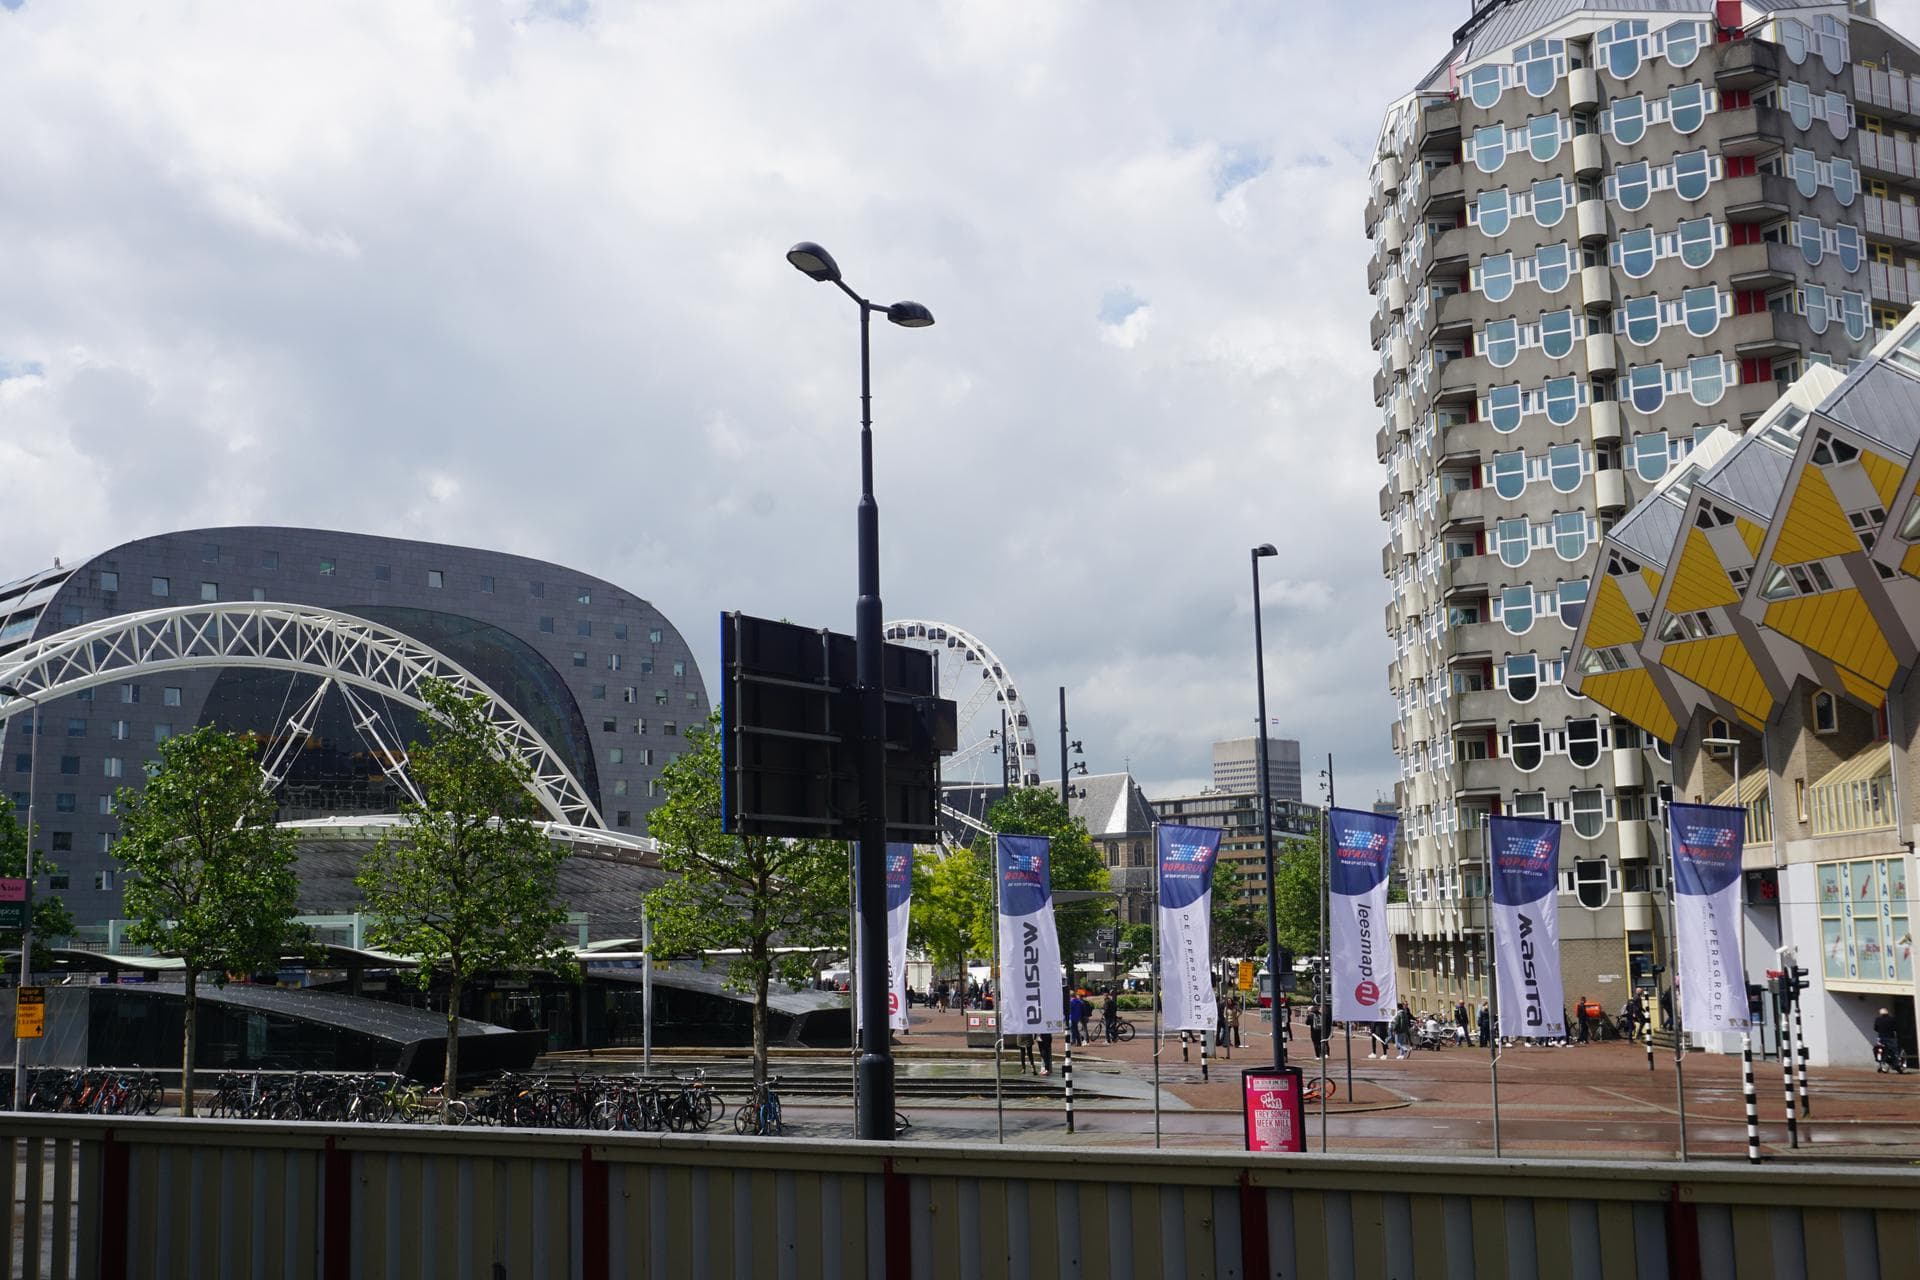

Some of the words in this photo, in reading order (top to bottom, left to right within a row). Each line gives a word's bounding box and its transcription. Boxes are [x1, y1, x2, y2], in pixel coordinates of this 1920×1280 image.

[1357, 903, 1378, 1003] leesmap.nl
[1843, 864, 1857, 977] CASINO
[1880, 862, 1895, 978] CASINO
[1256, 1119, 1273, 1128] MEEK
